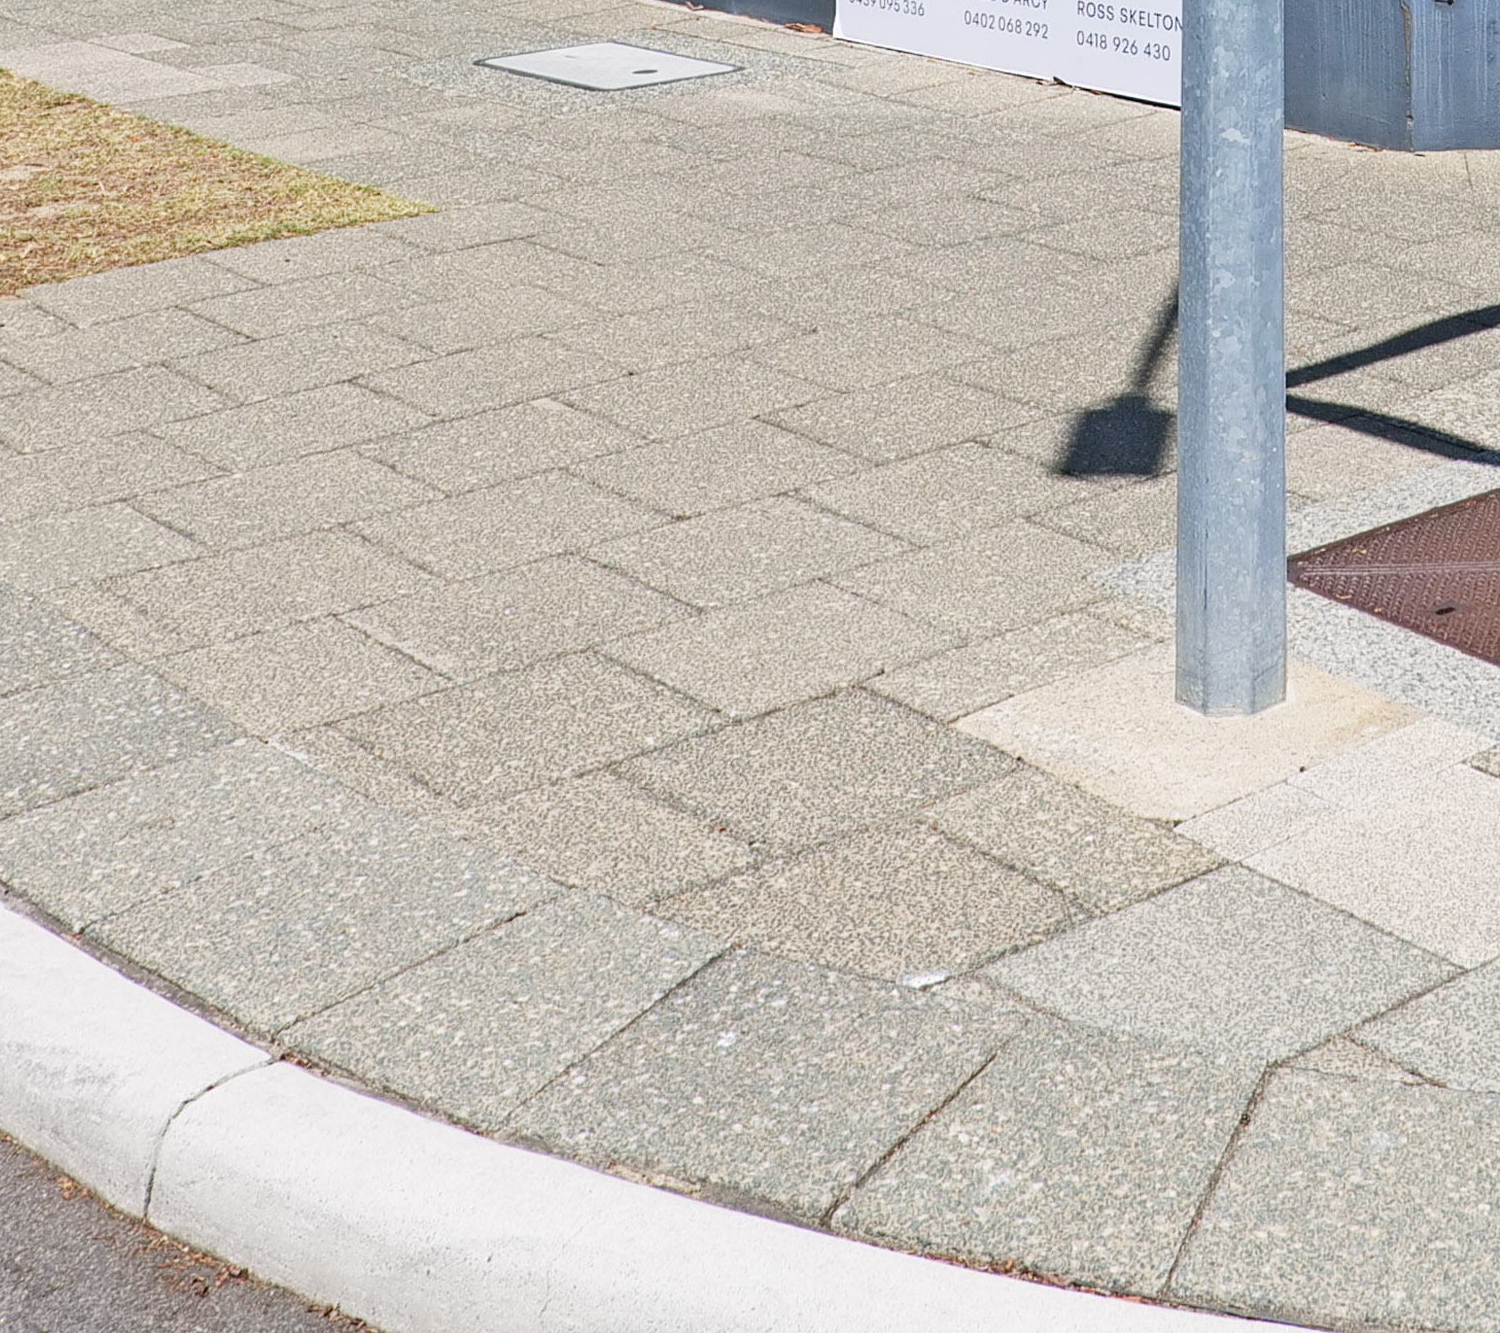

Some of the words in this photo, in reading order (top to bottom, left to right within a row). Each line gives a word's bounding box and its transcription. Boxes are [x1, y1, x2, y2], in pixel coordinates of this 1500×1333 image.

[964, 10, 995, 30] 0402
[998, 16, 1022, 35] 068
[1025, 21, 1049, 40] 292
[1077, 0, 1115, 21] ROSS
[1120, 7, 1183, 32] SKELTON
[1077, 30, 1108, 50] 0418
[1113, 36, 1138, 56] 926
[1143, 43, 1171, 61] 430
